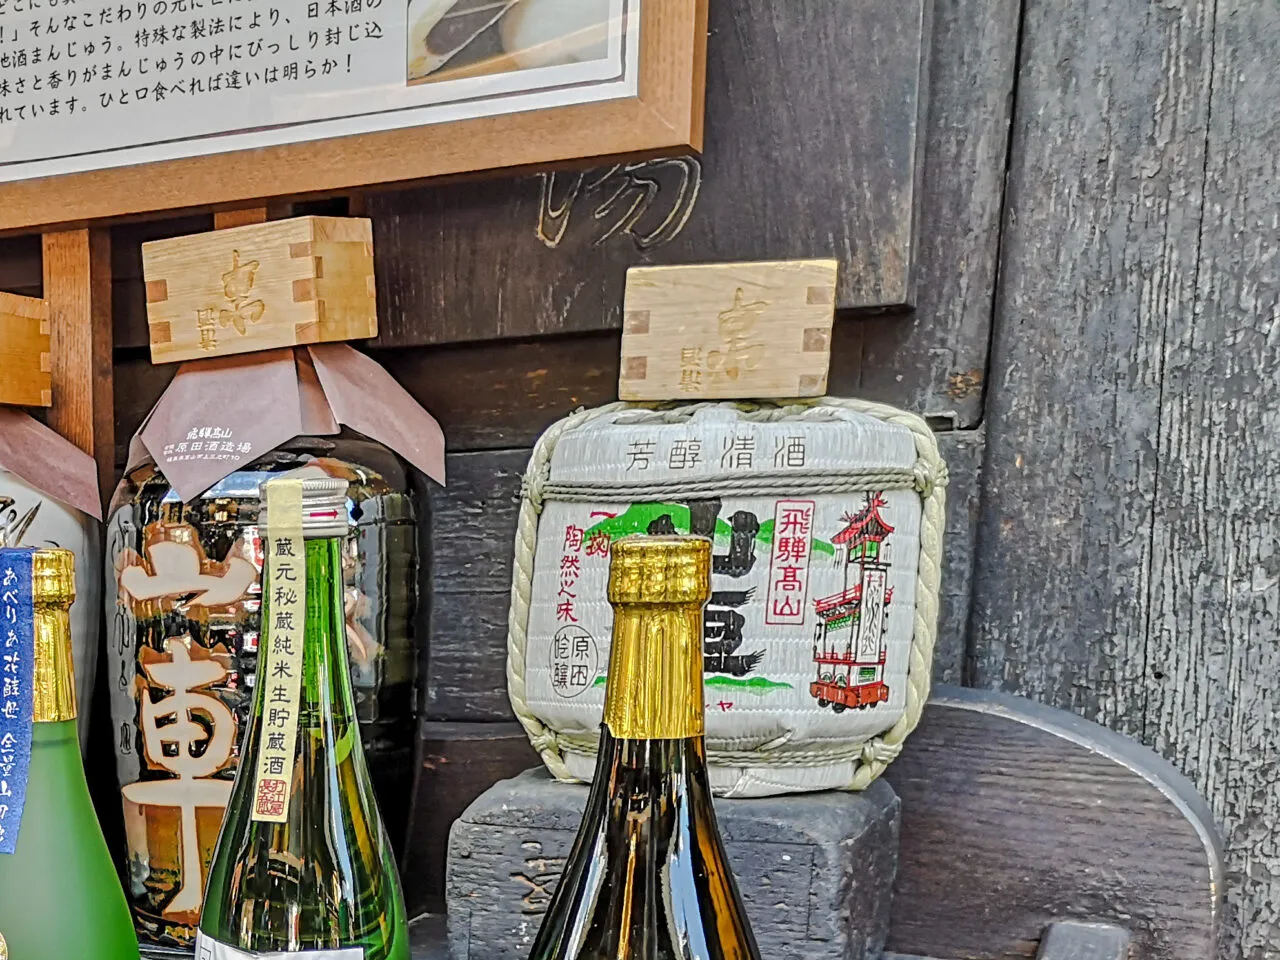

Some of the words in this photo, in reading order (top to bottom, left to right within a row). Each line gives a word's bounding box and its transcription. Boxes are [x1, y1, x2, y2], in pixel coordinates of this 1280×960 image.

[626, 435, 807, 473] 芳醇清酒
[263, 537, 298, 775] 蔵元秘蔵純米生貯蔵酒
